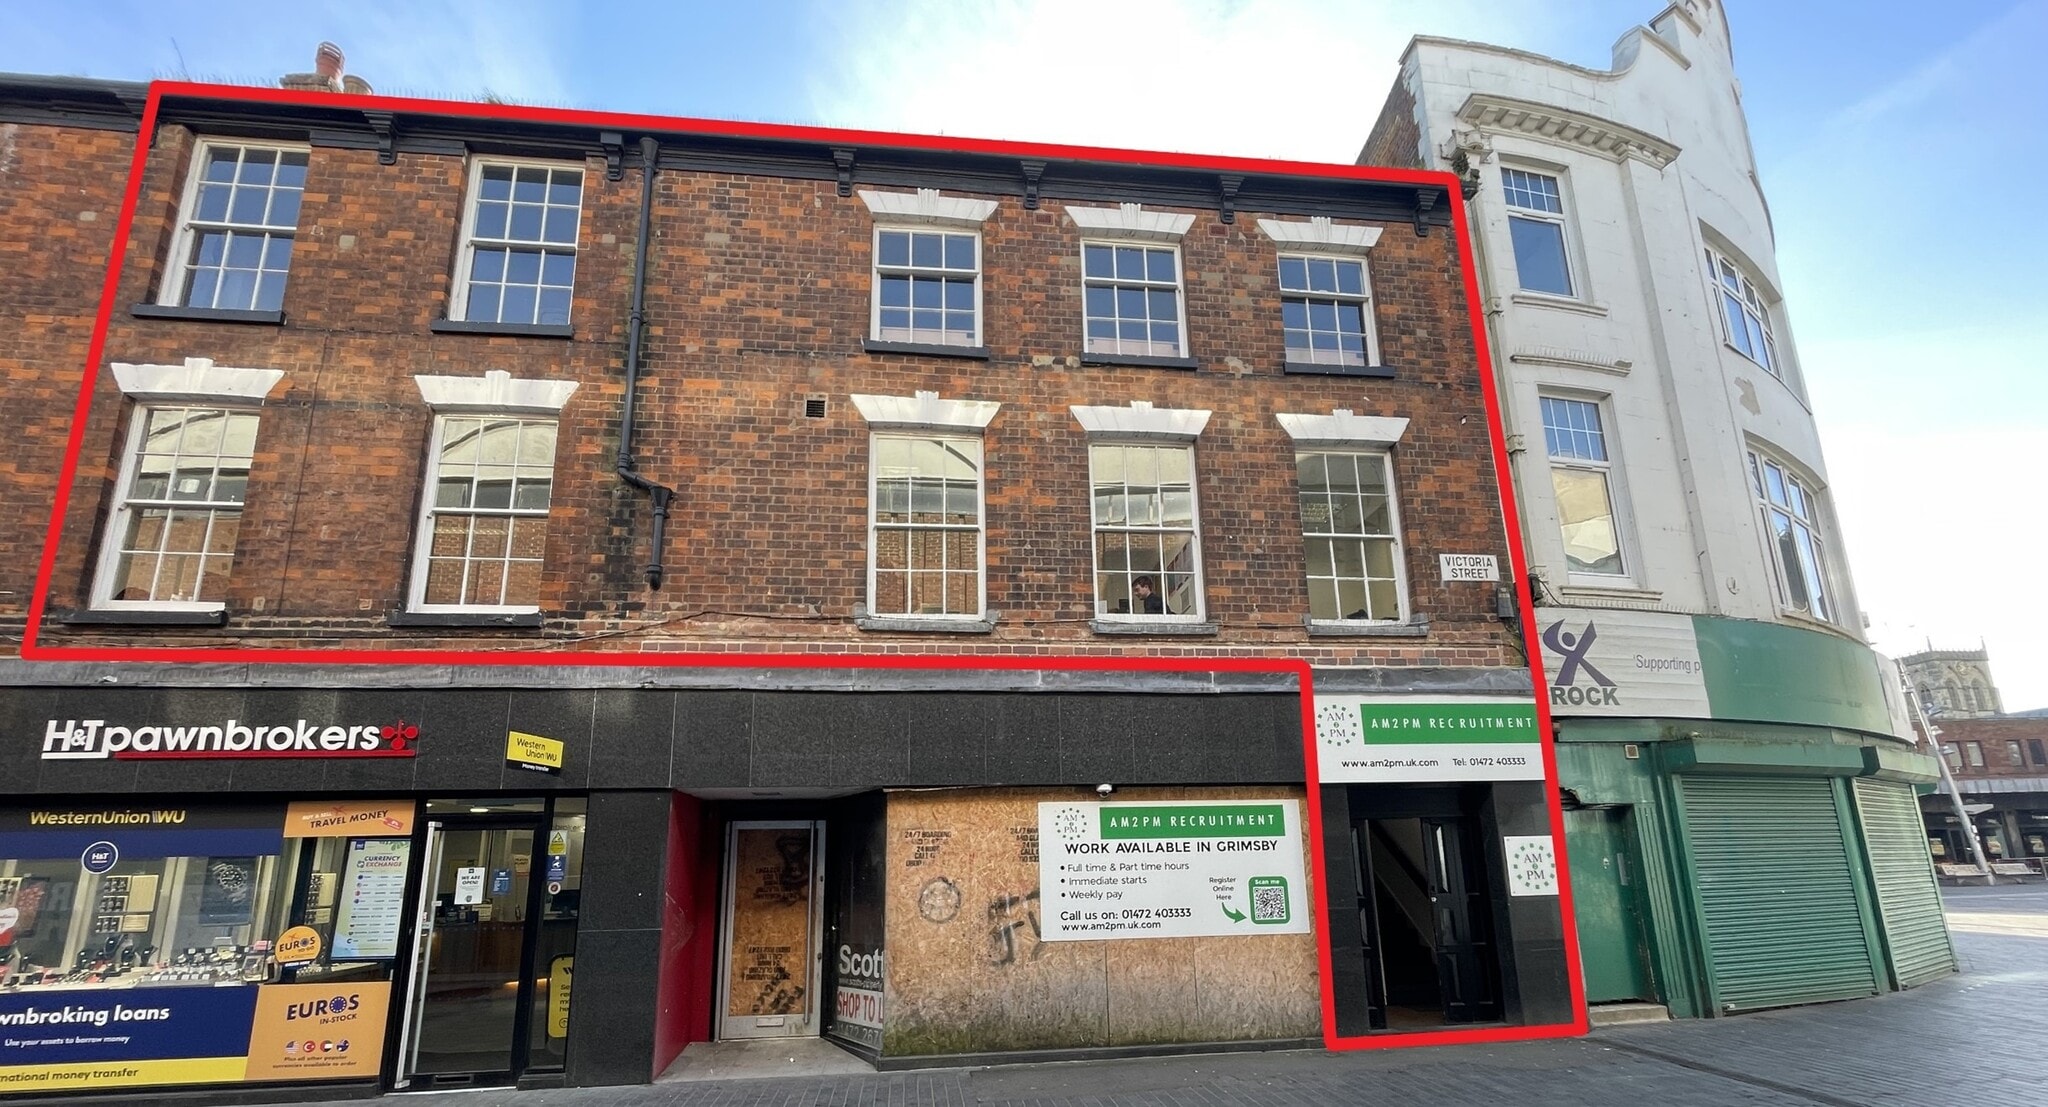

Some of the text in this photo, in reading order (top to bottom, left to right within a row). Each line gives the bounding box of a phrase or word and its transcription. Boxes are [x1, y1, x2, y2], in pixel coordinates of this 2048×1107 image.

[1445, 556, 1493, 567] VICTORIA
[1451, 568, 1489, 579] STREET
[1550, 687, 1620, 705] ROCK
[1327, 712, 1345, 721] AM
[1372, 717, 1533, 729] AM2PM RECRUITMENT
[1330, 729, 1346, 737] PM
[516, 737, 546, 751] Western
[525, 749, 545, 759] Union
[1341, 757, 1526, 768] www.am2pm.uk.com Tel: 01472 403333
[310, 817, 347, 829] TRAVEL
[349, 809, 389, 823] MONEY
[1110, 814, 1275, 828] AM2PM RECRUITMENT
[1064, 840, 1278, 854] WORK AVAILABLE IN GRIMSBY
[1524, 853, 1543, 863] AM
[1067, 862, 1190, 872] Full time & Part time hours
[1068, 876, 1148, 885] Immediate starts
[1208, 876, 1237, 885] Register
[1526, 870, 1545, 880] PM
[1069, 890, 1123, 900] Weekly pay
[1060, 908, 1192, 920] Call us on: 01472 403333
[1061, 920, 1162, 931] www.am2pm.uk.com
[279, 937, 316, 952] EUROS
[286, 994, 360, 1021] EUROS
[837, 990, 861, 1019] SHOP
[863, 995, 876, 1022] TO
[113, 1004, 170, 1021] loans
[319, 1013, 358, 1025] IN-STOCK
[4, 1039, 20, 1047] Use
[20, 1040, 40, 1048] your
[75, 1036, 103, 1044] borrow
[103, 1036, 131, 1044] money
[52, 1070, 91, 1081] money
[93, 1068, 139, 1078] transfer
